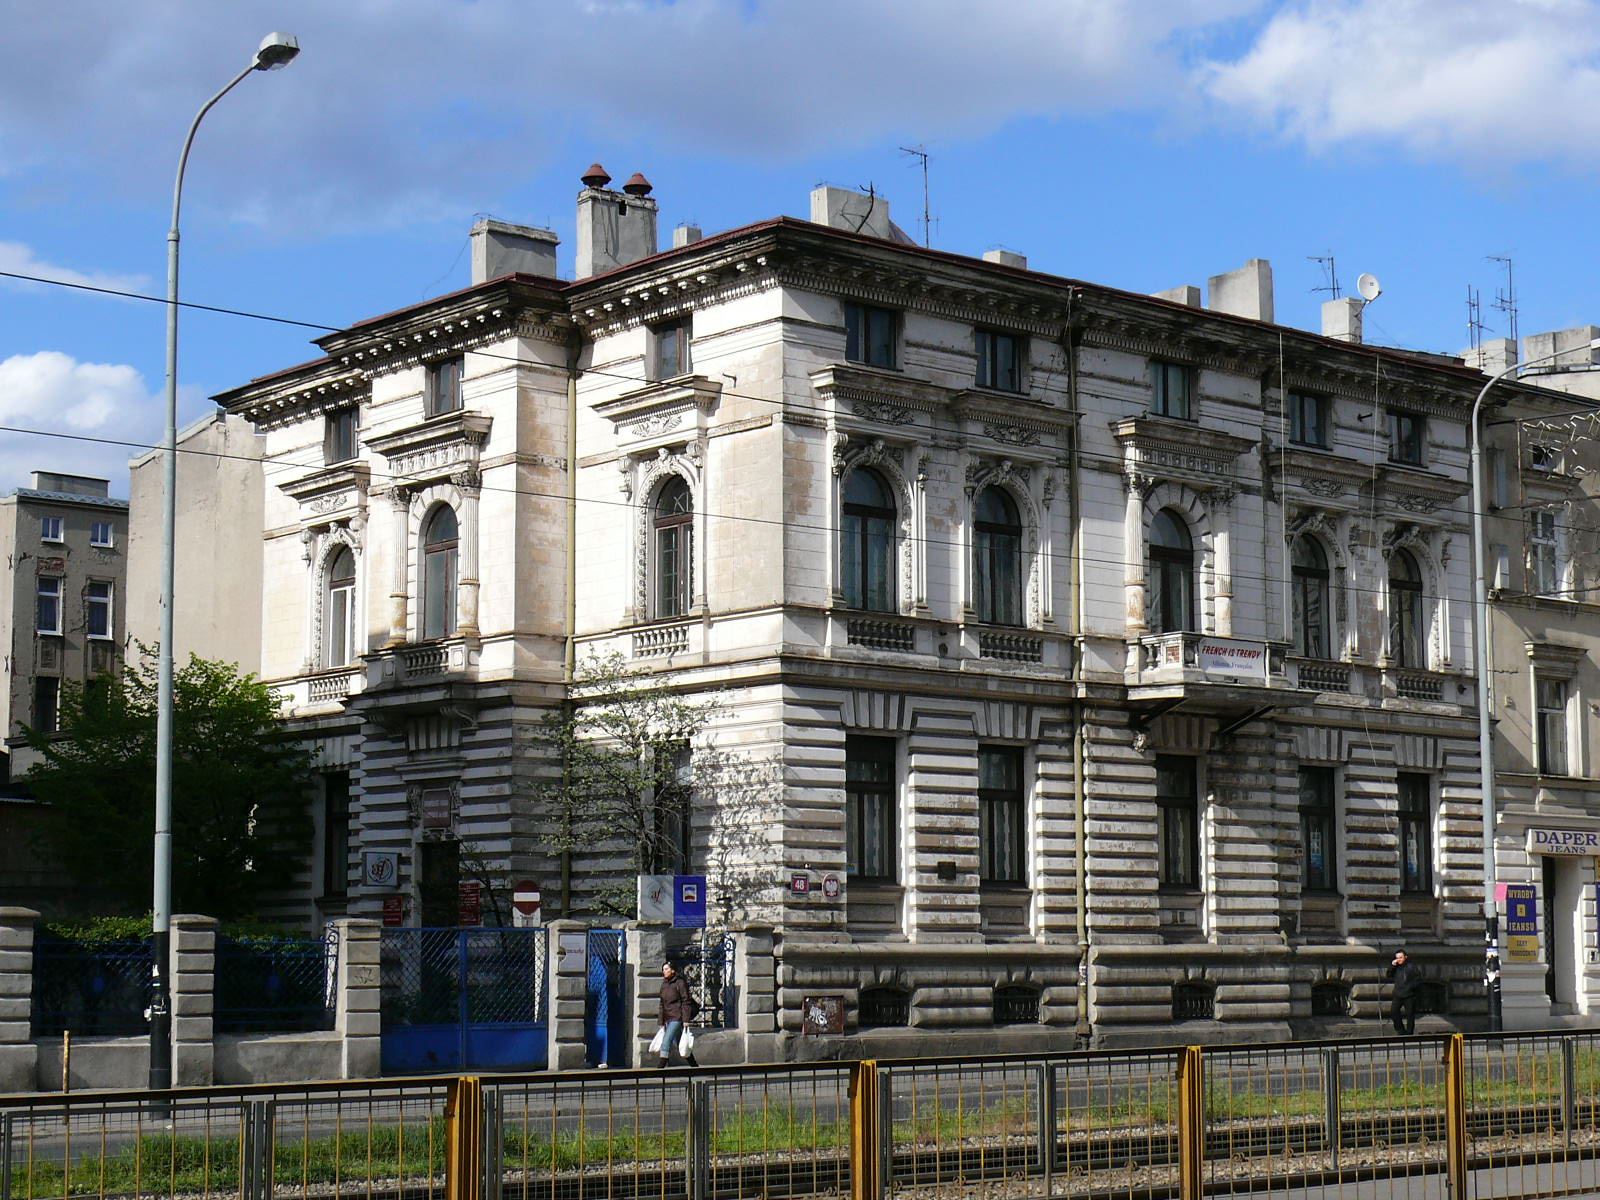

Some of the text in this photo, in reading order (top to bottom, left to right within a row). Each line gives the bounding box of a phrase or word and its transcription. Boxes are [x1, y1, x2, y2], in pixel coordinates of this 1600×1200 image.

[1202, 645, 1261, 659] FRENCH IS TRENDY
[1535, 830, 1598, 846] DAPER
[1547, 845, 1586, 854] JEANS
[795, 880, 805, 890] 48
[1508, 889, 1534, 899] WYROBY
